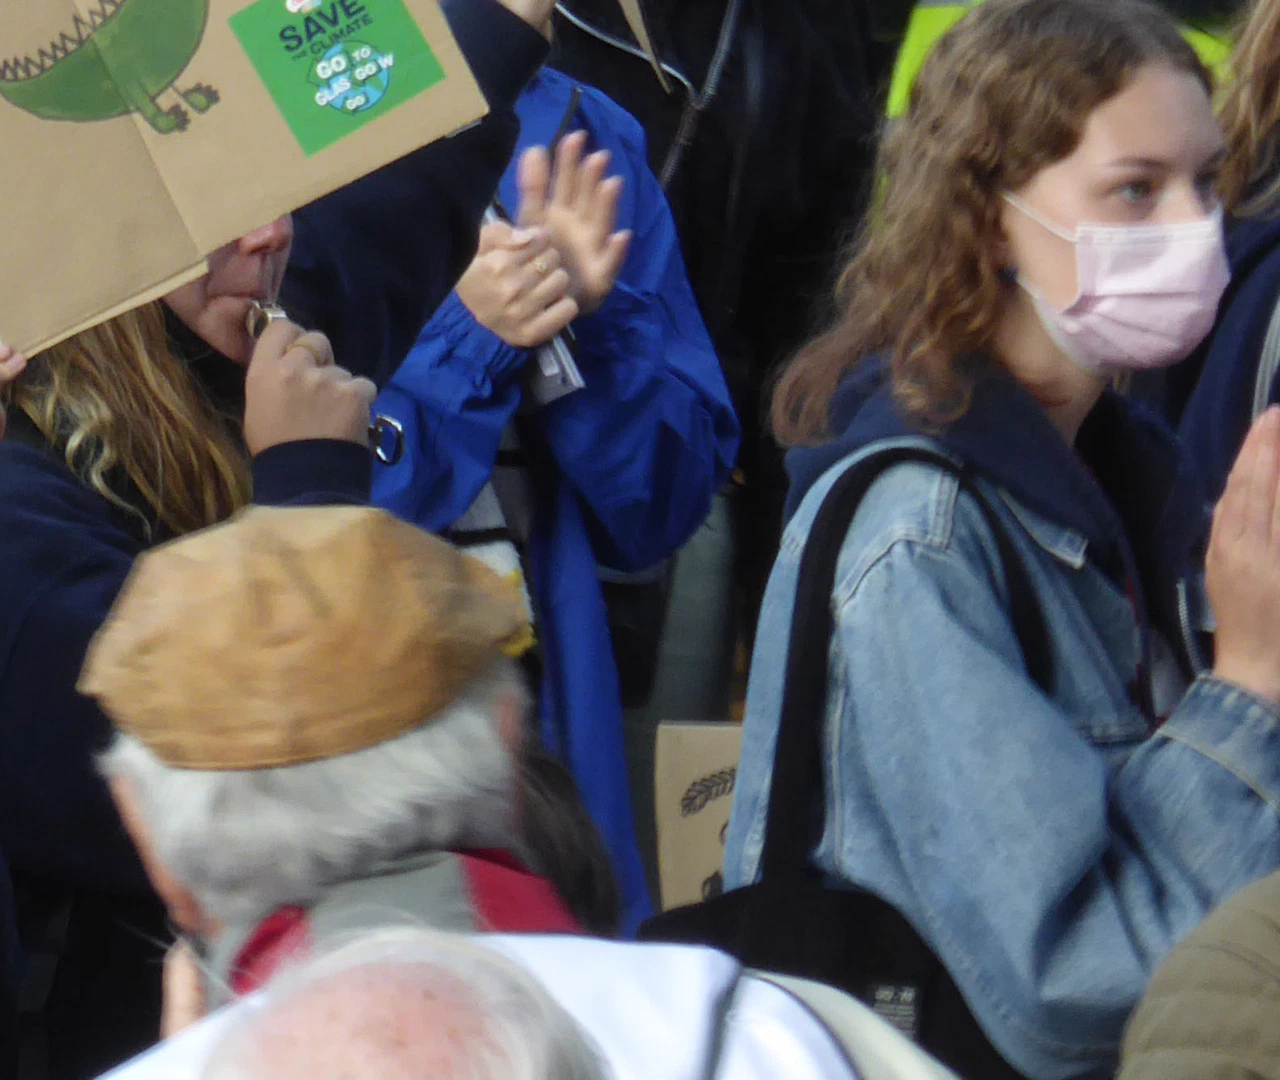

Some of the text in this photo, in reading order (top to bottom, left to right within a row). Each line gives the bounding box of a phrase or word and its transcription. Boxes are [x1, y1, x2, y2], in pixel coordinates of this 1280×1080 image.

[309, 14, 373, 56] CLIMATE
[316, 45, 372, 79] GO TO
[345, 93, 366, 111] GO
